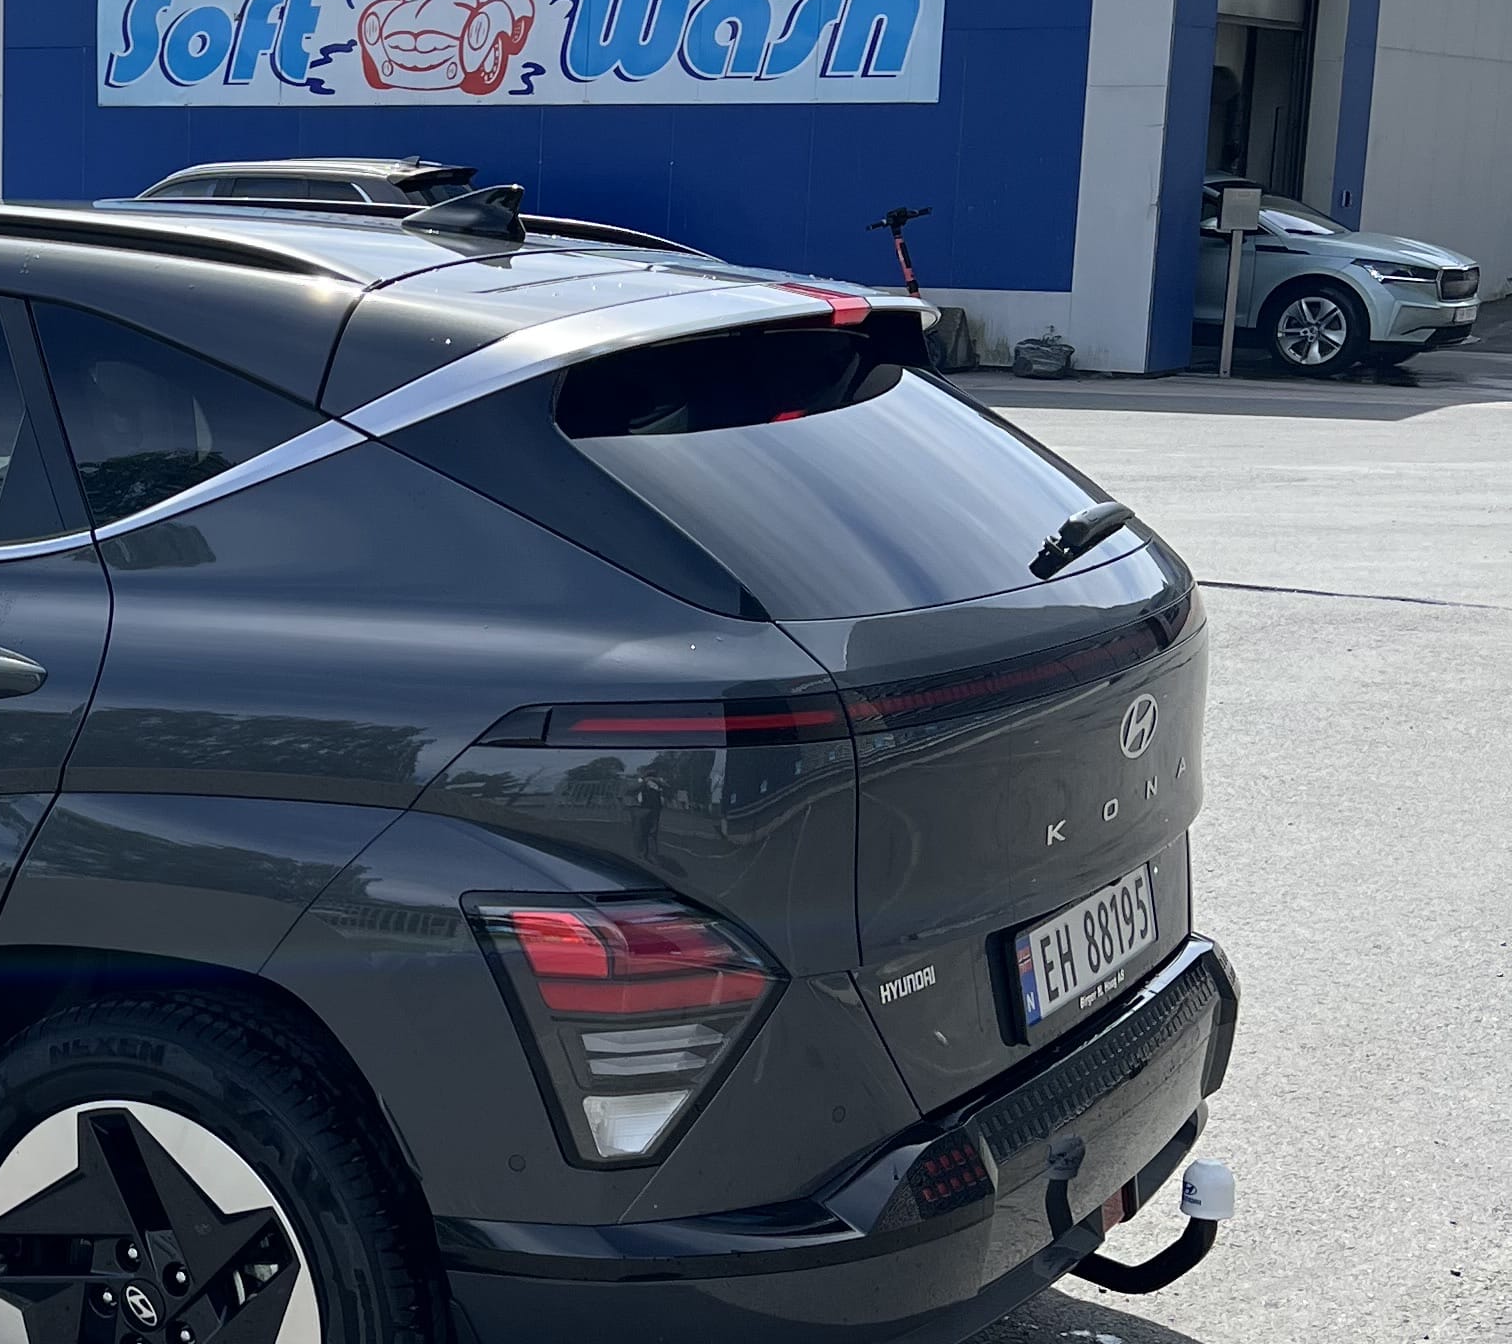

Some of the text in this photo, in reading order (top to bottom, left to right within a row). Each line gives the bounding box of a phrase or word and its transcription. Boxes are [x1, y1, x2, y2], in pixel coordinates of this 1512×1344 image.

[1039, 876, 1148, 1003] EH 88195
[879, 964, 936, 1005] HYUNDAI
[1025, 991, 1036, 1013] N
[48, 1037, 166, 1067] NEXEN
